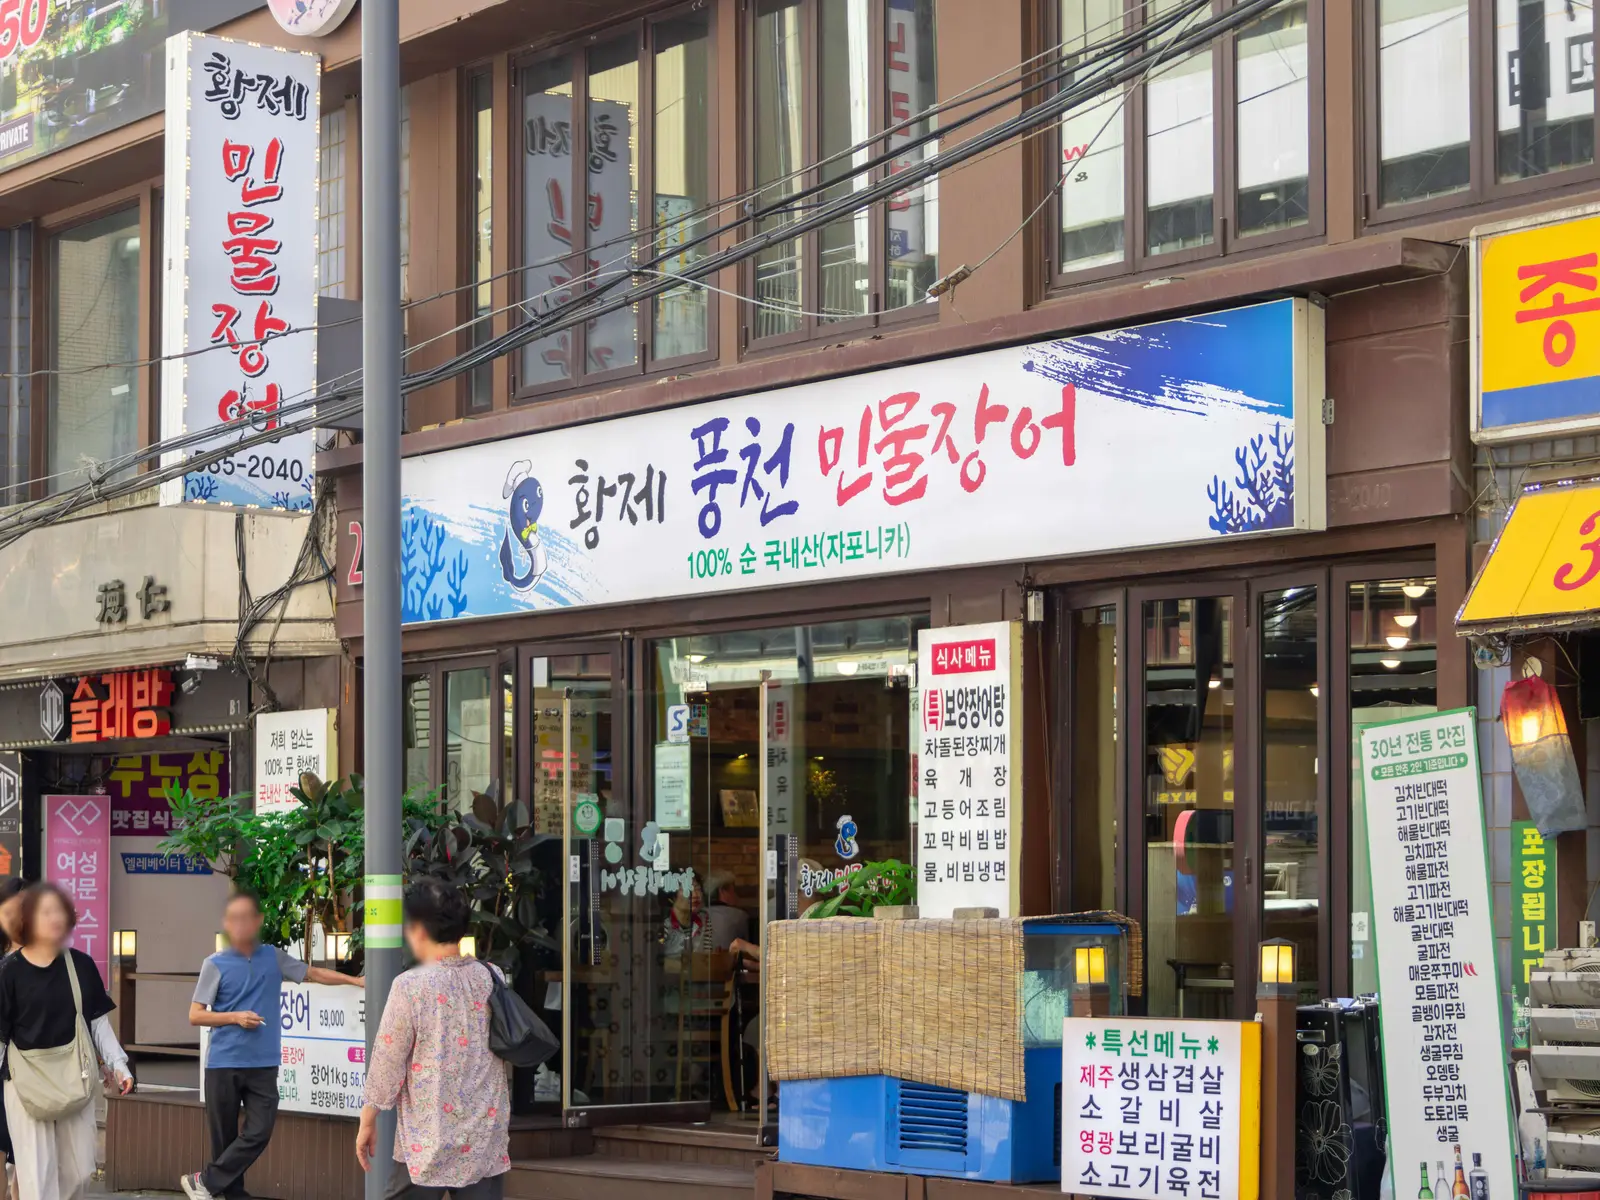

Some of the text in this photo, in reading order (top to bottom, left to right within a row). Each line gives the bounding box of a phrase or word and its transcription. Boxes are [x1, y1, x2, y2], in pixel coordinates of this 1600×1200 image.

[203, 52, 309, 120] 황제
[210, 137, 291, 442] 민물장어
[568, 382, 1076, 550] 황제 풍천 민물장어
[687, 521, 911, 579] 100% 순 국내산(자포니카)
[936, 645, 992, 670] 식사메뉴
[70, 670, 163, 743] 술래방
[229, 699, 241, 716] B1
[271, 727, 313, 751] 저희 업소는
[925, 734, 1006, 758] 차돌된장찌개
[1370, 725, 1466, 759] 30년 전통 맛집
[264, 758, 283, 776] 100%
[286, 756, 294, 776] 무
[1394, 779, 1448, 803] 김치빈대떡
[924, 797, 1006, 820] 고등어조림
[1396, 800, 1449, 822] 고기빈대떡
[923, 829, 1007, 851] 꼬막비빔밥
[1397, 820, 1451, 842] 해물빈대떡
[1404, 840, 1448, 862] 김치파전
[57, 851, 98, 876] 여성
[1405, 860, 1450, 881] 해물파전
[1407, 881, 1451, 901] 고기파전
[1393, 899, 1469, 923] 해물고기빈대떡
[1411, 921, 1454, 942] 굴빈대떡
[1417, 942, 1451, 961] 굴파전
[1408, 961, 1463, 981] 매운쭈꾸미
[1415, 982, 1459, 1001] 모듬파전
[319, 1009, 345, 1030] 59,000
[1411, 1002, 1466, 1022] 골뱅이무침
[1422, 1023, 1458, 1042] 감자전
[1420, 1043, 1463, 1062] 생굴무침
[1426, 1064, 1460, 1081] 오뎅탕
[1423, 1084, 1467, 1102] 두부김치
[1424, 1105, 1469, 1122] 도토리묵
[1436, 1125, 1459, 1143] 생굴
[1079, 1161, 1221, 1199] 소고기육전
